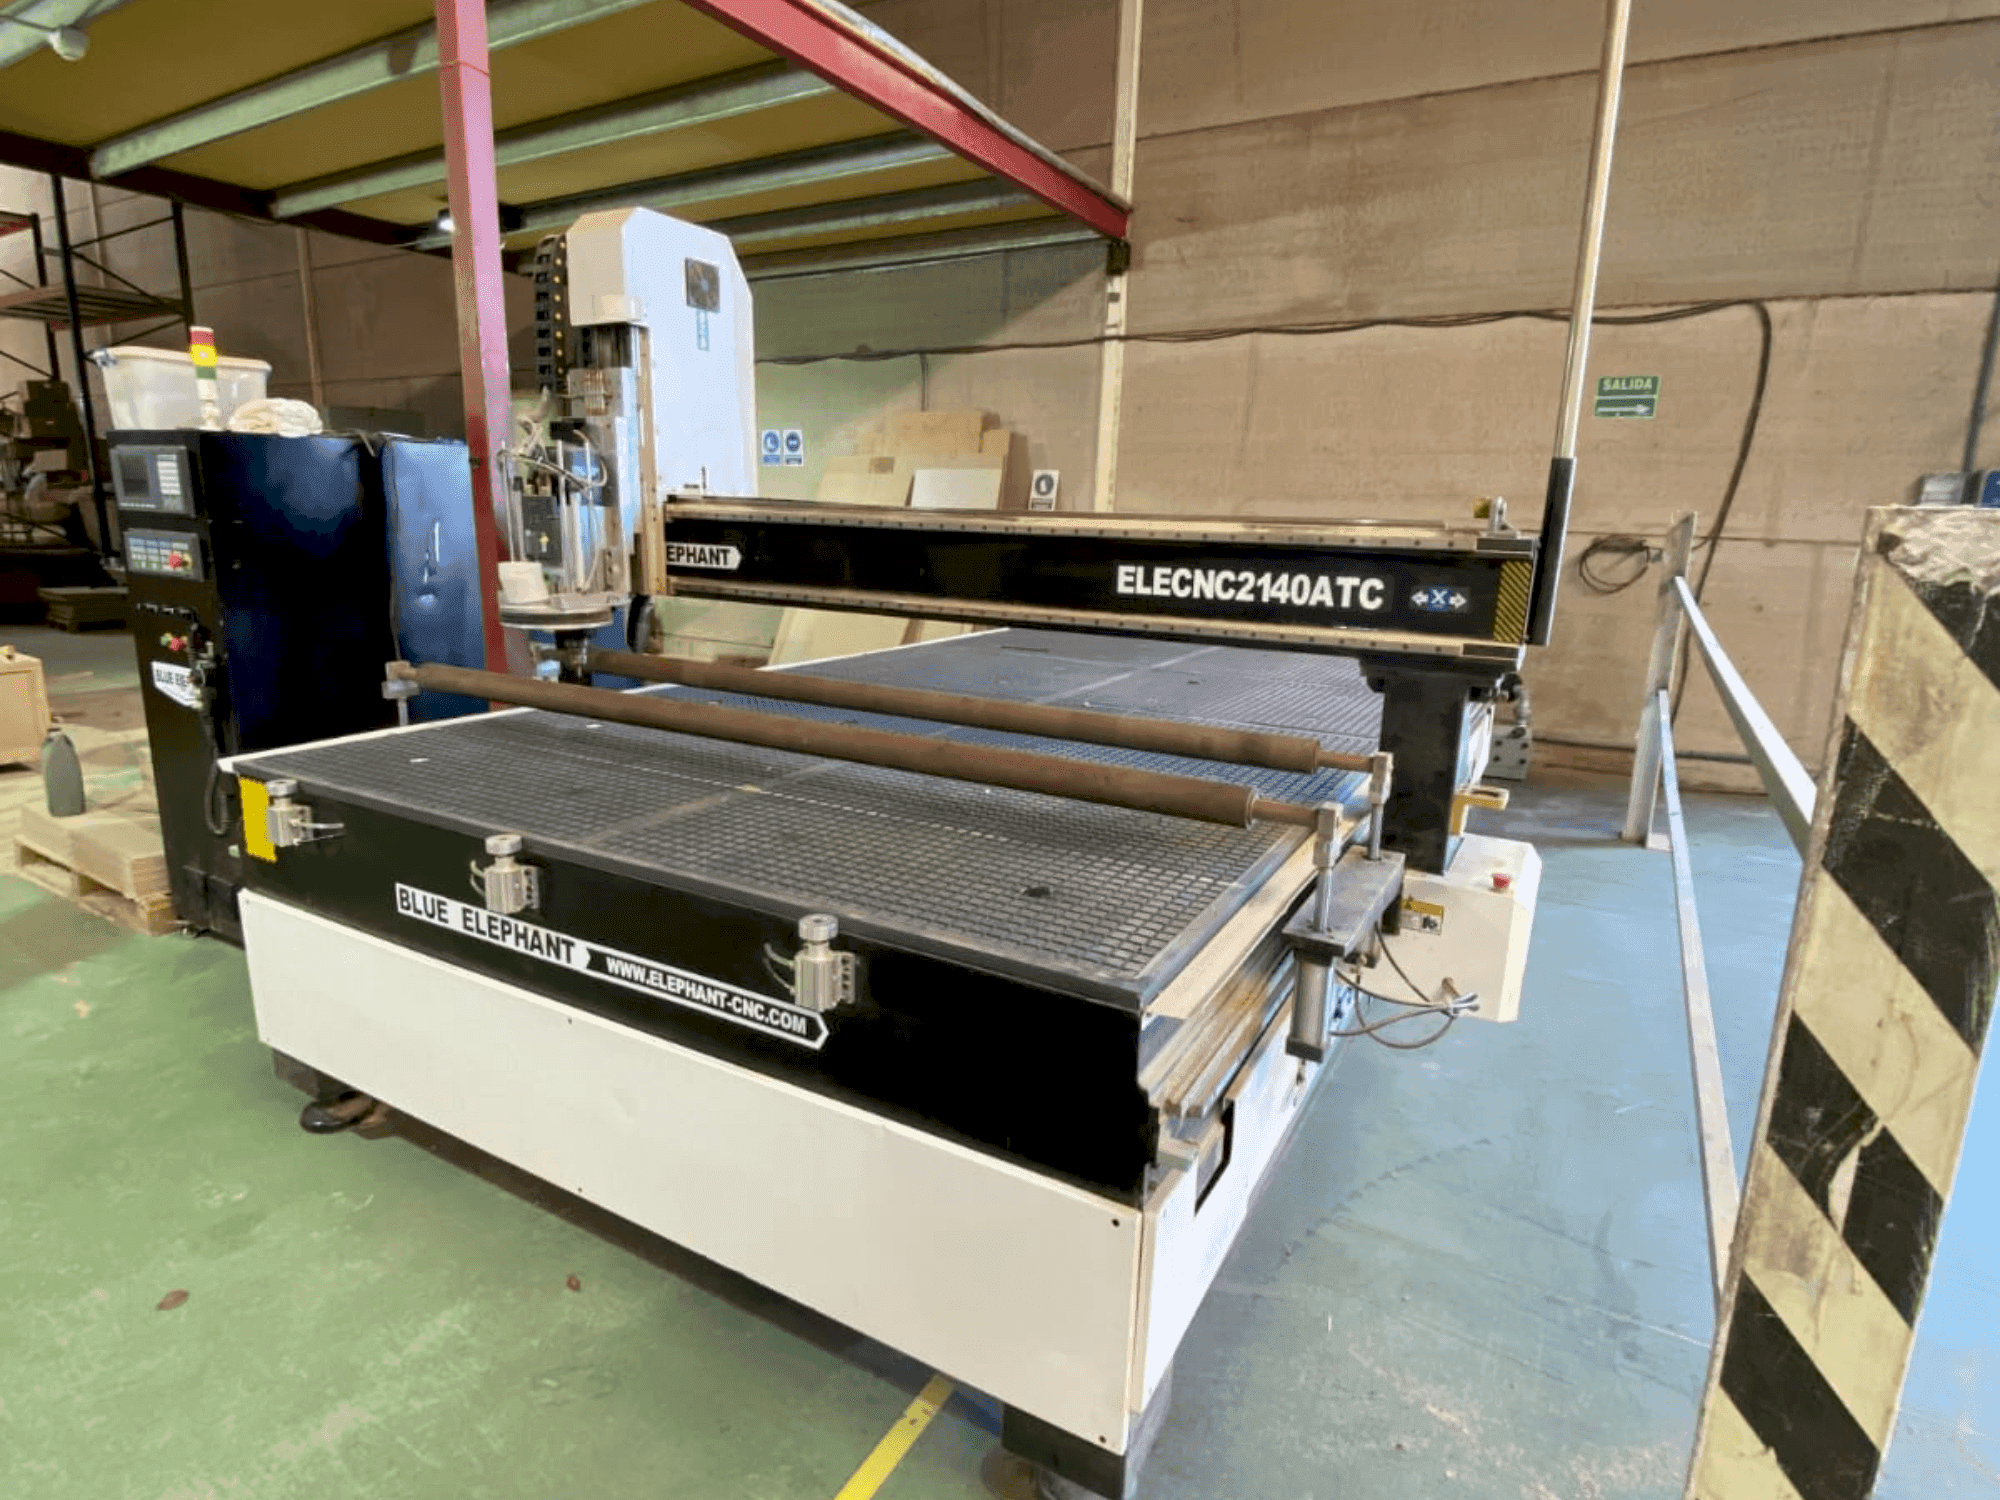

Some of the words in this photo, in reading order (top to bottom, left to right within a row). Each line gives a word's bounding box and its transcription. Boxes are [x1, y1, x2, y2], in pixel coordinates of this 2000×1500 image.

[1603, 378, 1652, 390] SALIDA
[1117, 564, 1385, 610] ELECNC2140ATC
[399, 887, 449, 924] BLUE
[462, 906, 576, 964] ELEPHANT
[605, 955, 808, 1036] WWW.ELEPHANT-CNC.COM
